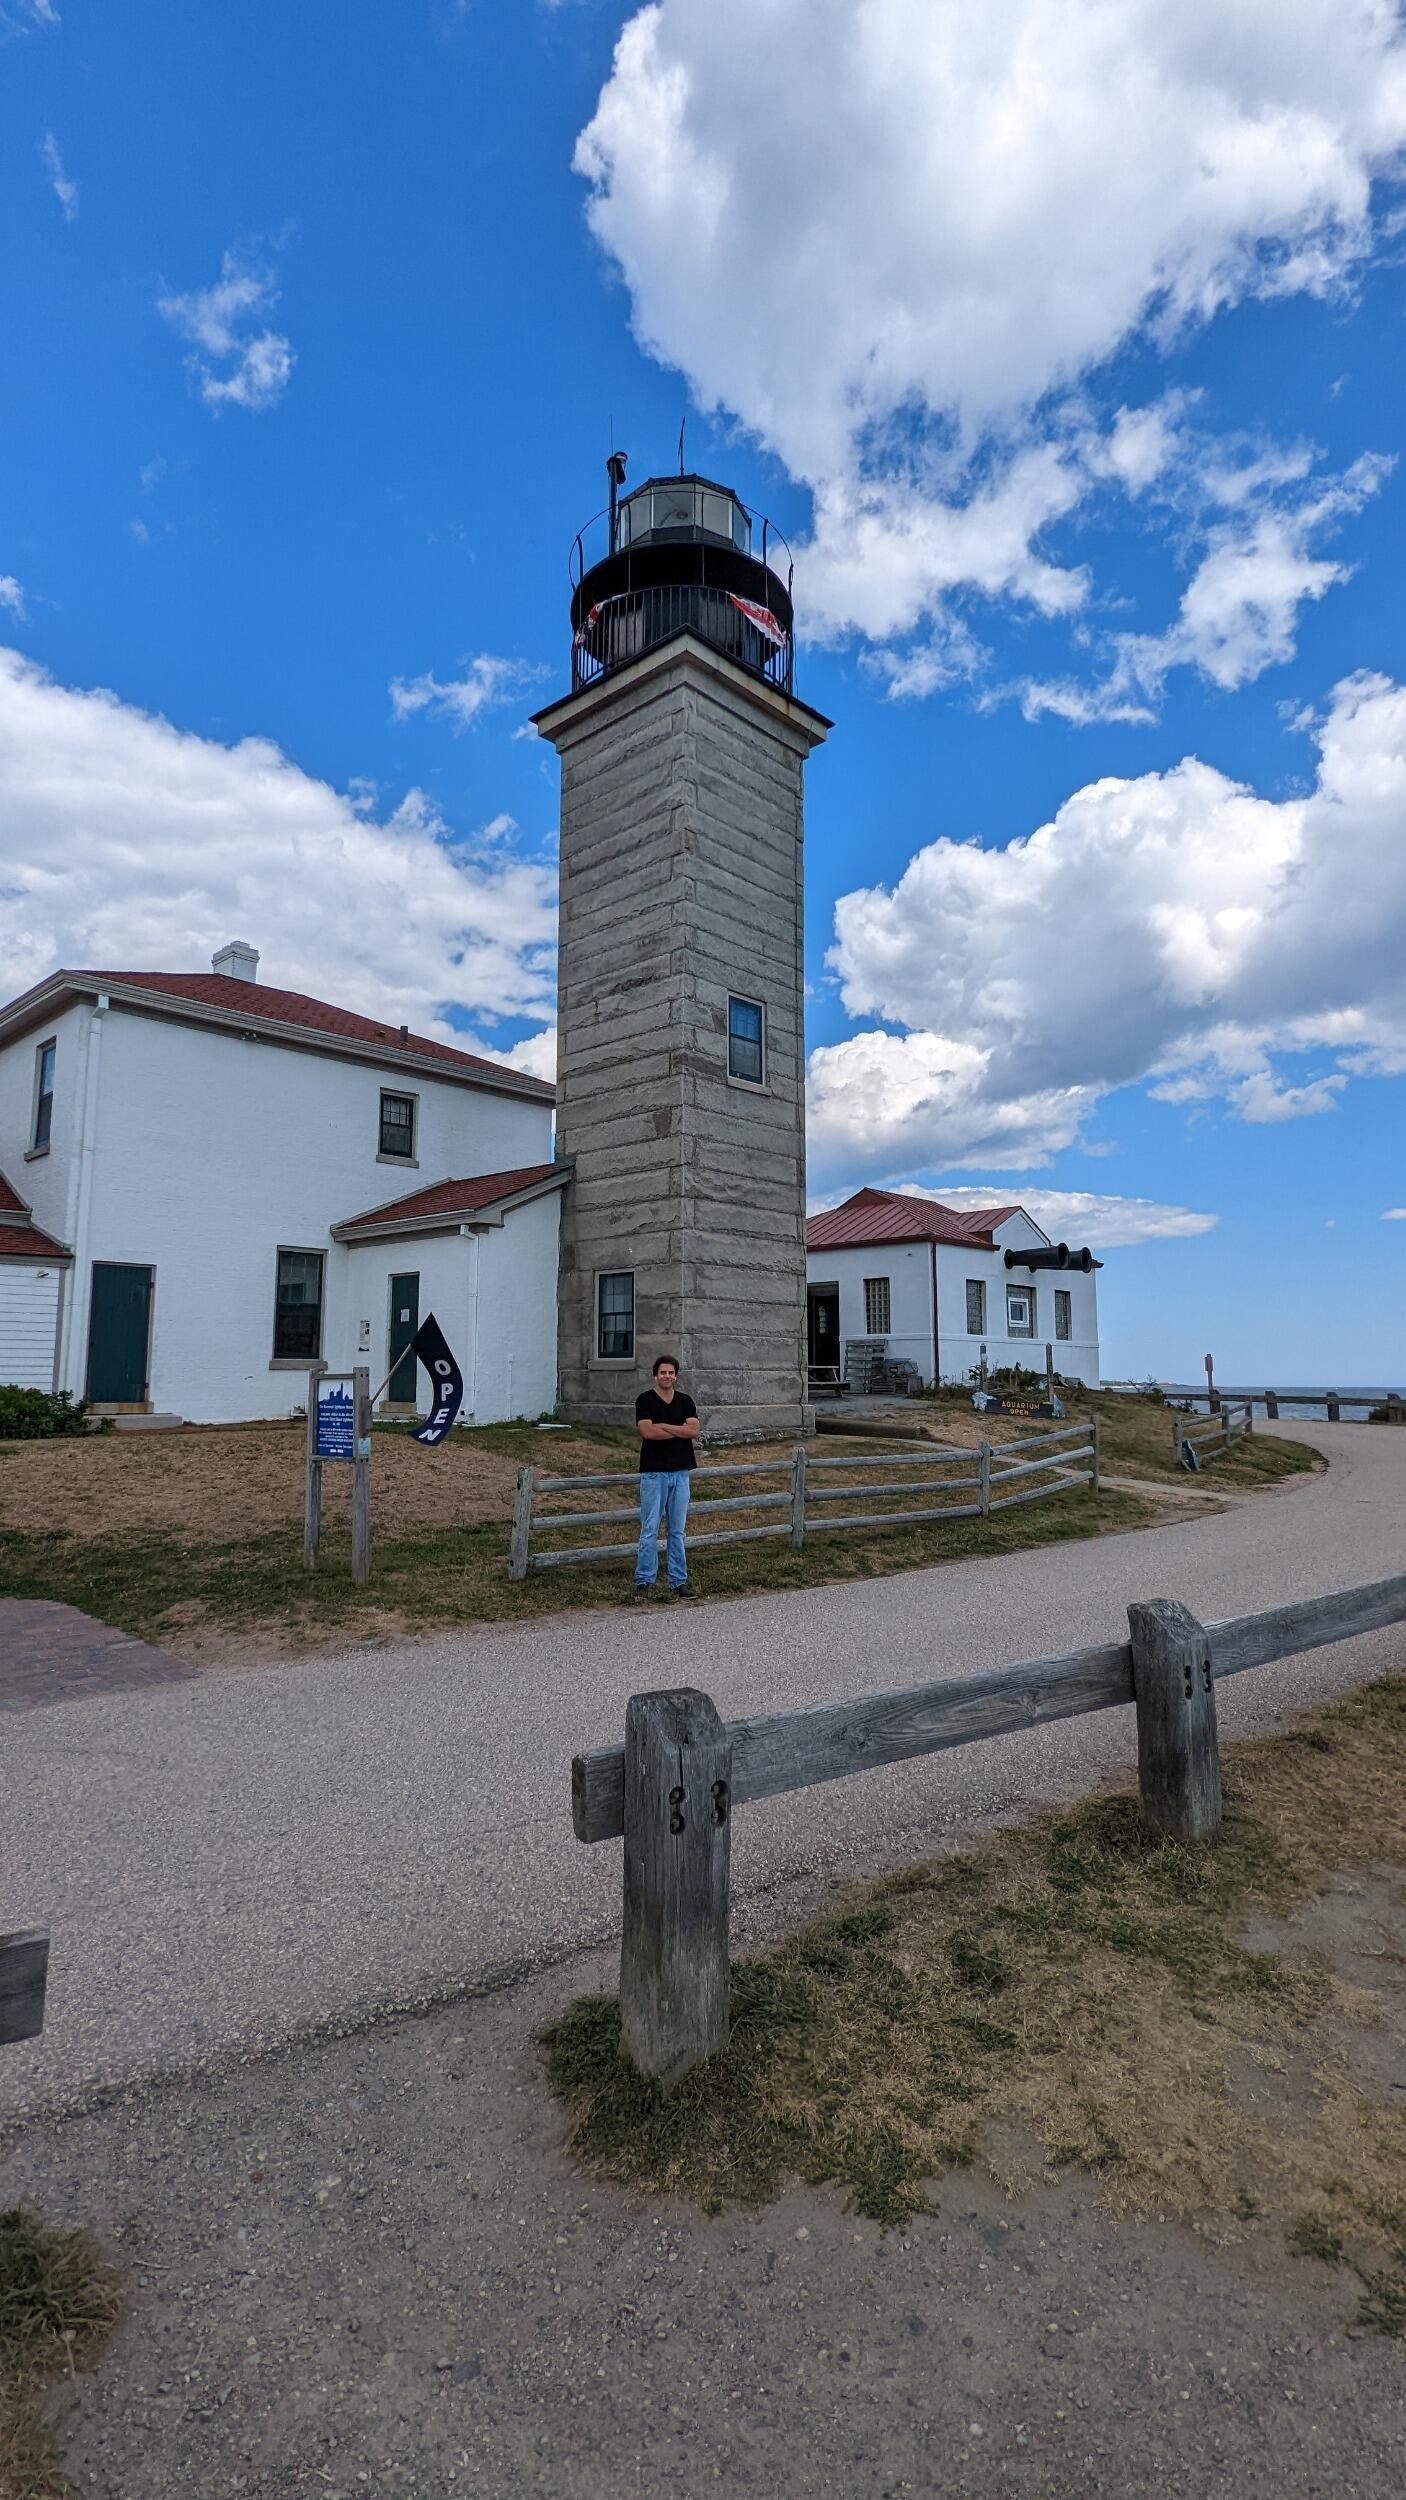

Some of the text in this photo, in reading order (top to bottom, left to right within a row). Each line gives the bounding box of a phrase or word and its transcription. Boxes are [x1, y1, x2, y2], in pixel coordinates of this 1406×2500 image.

[418, 1359, 454, 1441] OPEN
[1001, 1401, 1040, 1410] AQUARIUM
[1009, 1408, 1029, 1416] OPEN
